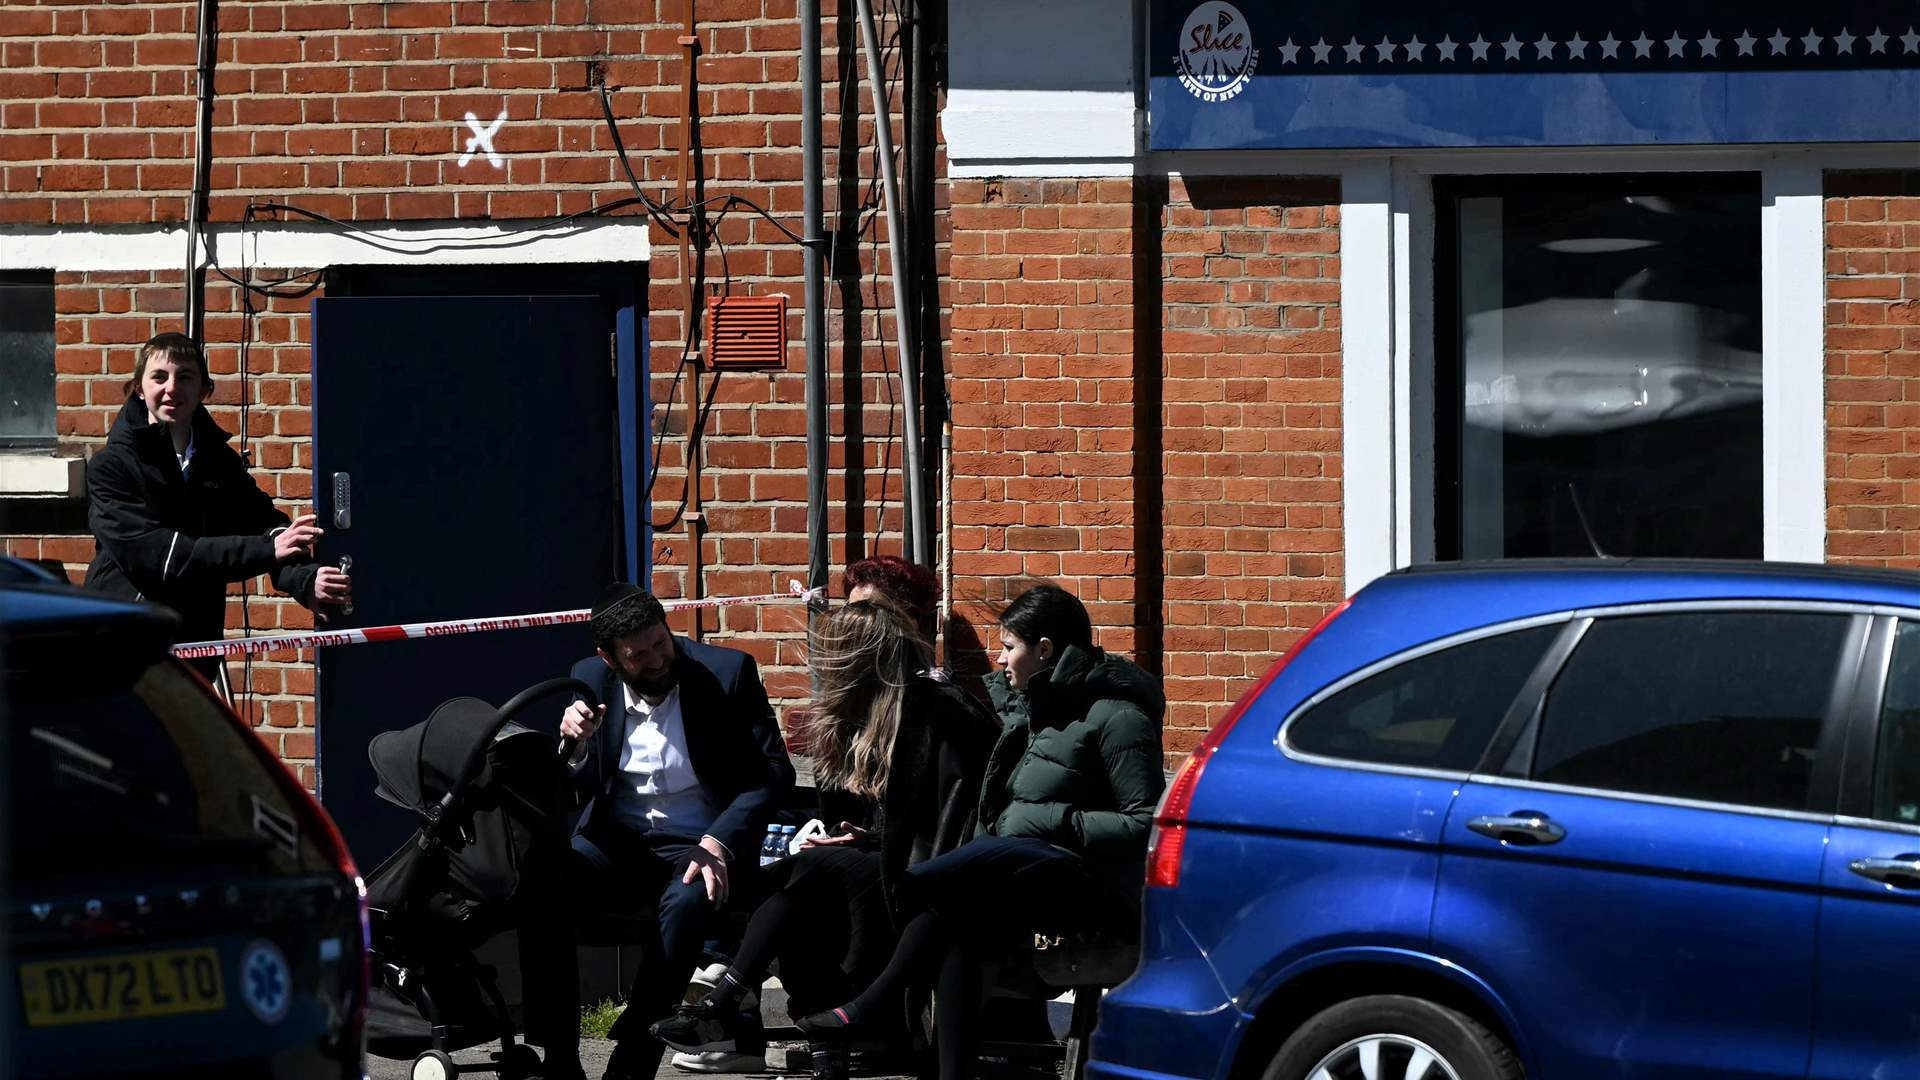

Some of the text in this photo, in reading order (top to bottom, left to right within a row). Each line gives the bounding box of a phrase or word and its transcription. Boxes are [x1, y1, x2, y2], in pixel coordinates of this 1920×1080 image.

[1189, 24, 1243, 55] Slice
[1176, 66, 1202, 98] TASTE
[1203, 92, 1217, 102] OF
[1220, 82, 1243, 102] NEW
[1242, 49, 1260, 84] YORK
[45, 955, 219, 1014] DX72 LTO
